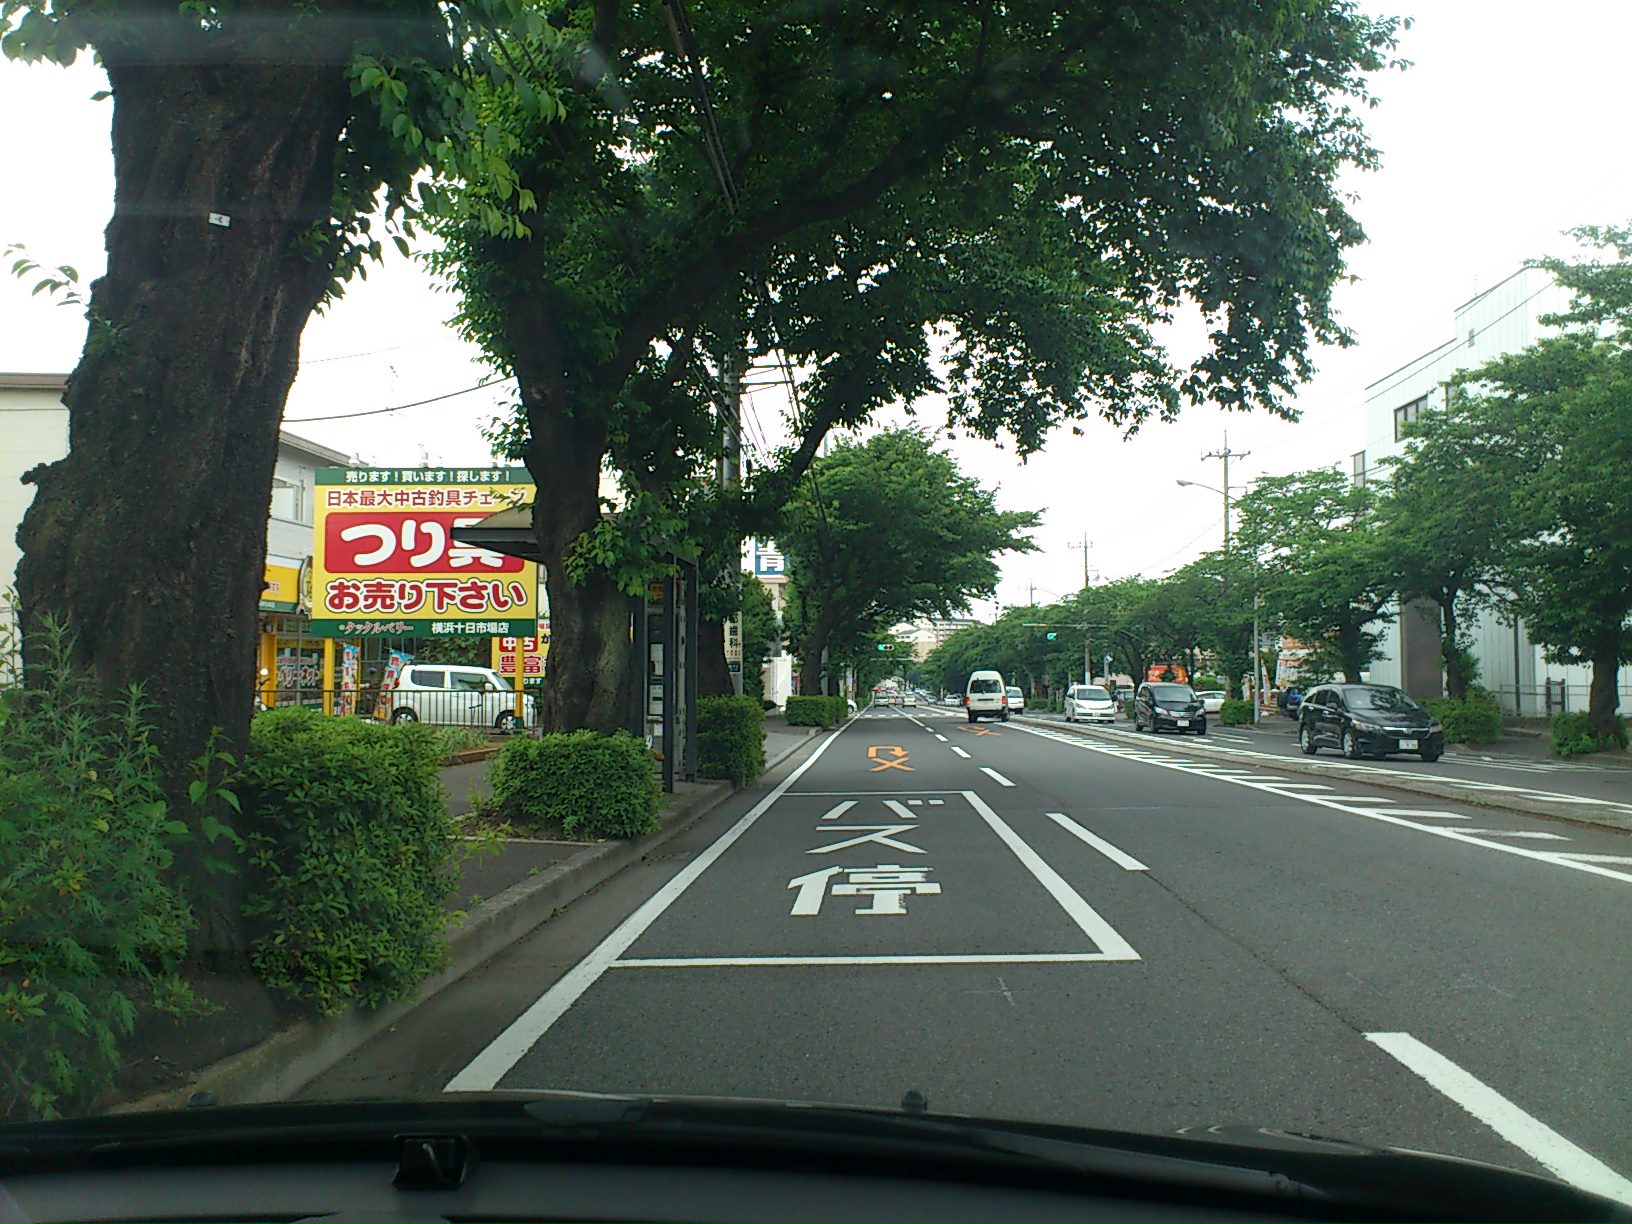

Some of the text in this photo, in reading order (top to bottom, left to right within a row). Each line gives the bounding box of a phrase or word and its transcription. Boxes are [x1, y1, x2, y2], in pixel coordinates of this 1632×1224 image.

[327, 578, 527, 613] お売り下さい
[431, 622, 510, 635] 横浜十日市場店
[786, 799, 945, 917] バス停
